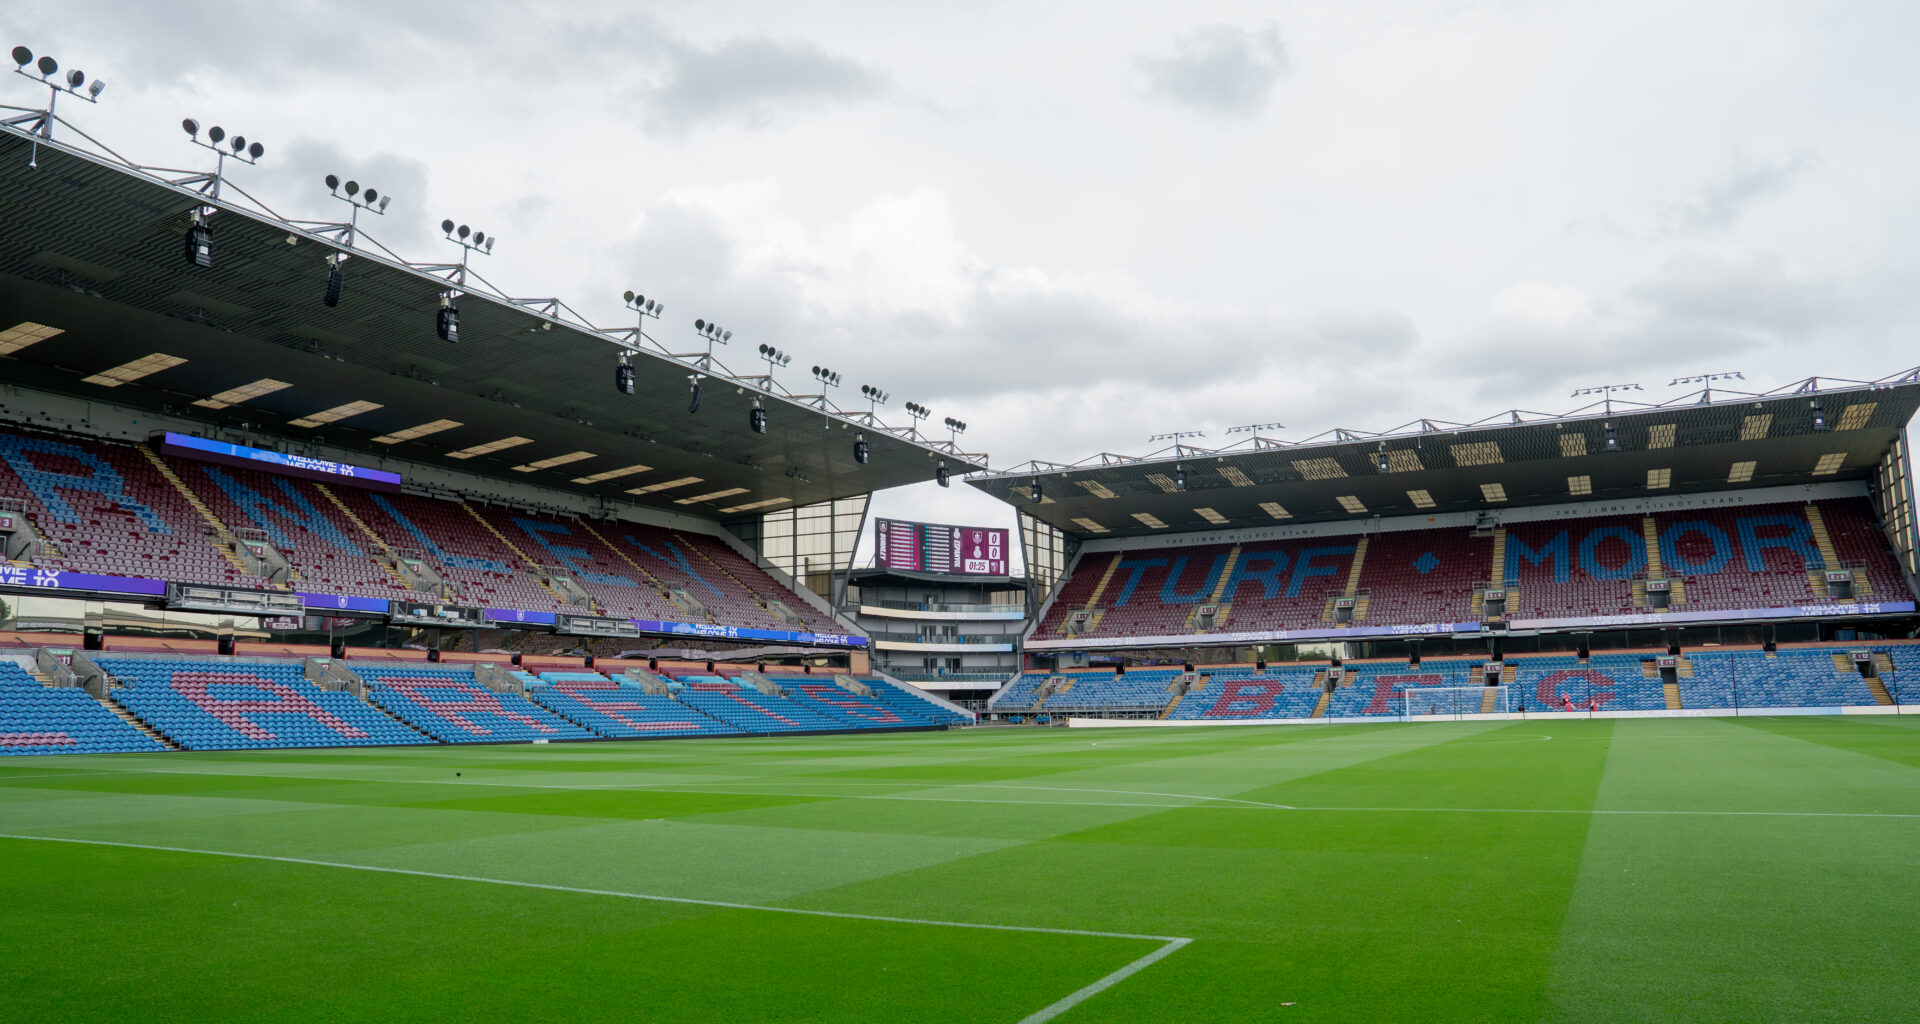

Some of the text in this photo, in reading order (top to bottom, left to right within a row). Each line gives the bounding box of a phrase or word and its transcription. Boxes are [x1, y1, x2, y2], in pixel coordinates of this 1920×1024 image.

[1586, 505, 1626, 513] JIMMY
[1702, 496, 1744, 504] STAND
[992, 534, 996, 544] 0
[992, 548, 997, 558] 0
[1503, 513, 1823, 586] MOOR
[969, 562, 985, 570] 01:25
[33, 576, 59, 588] TO
[1115, 546, 1357, 607] TURF
[62, 656, 70, 665] 11
